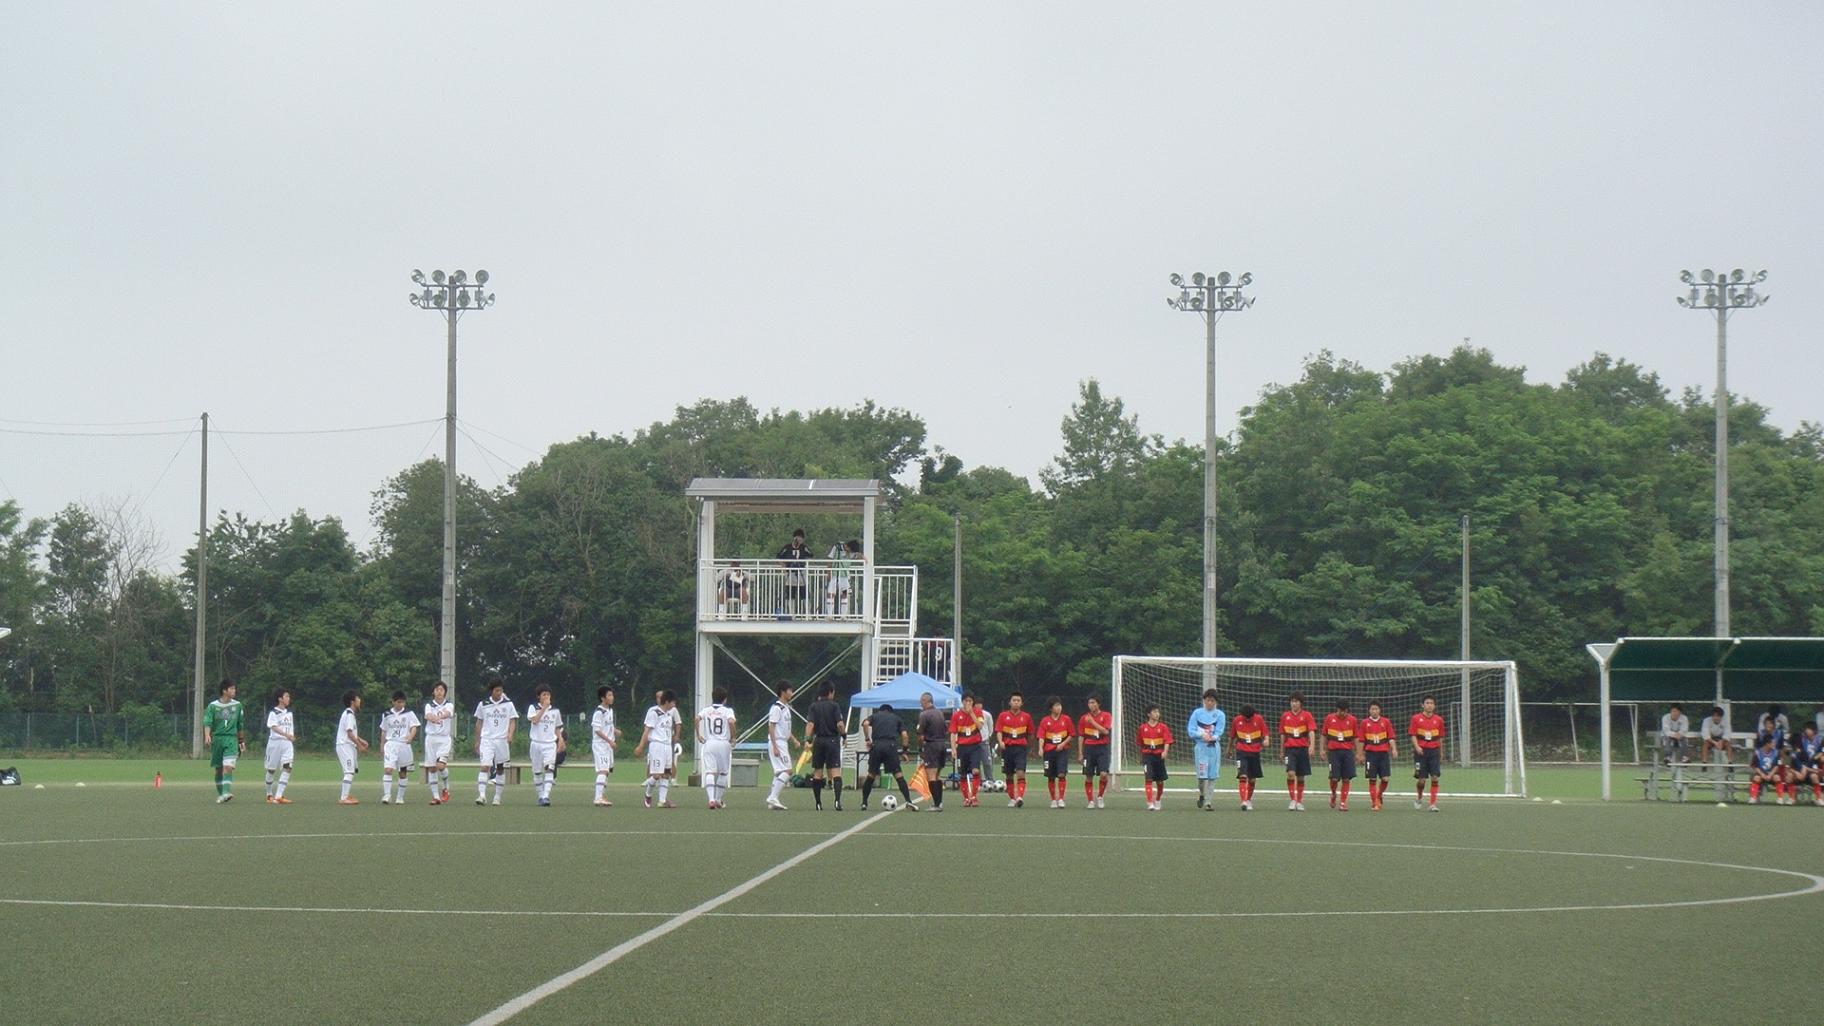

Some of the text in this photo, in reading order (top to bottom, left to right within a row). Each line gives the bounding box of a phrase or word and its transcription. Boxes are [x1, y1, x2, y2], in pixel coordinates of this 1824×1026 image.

[935, 647, 943, 661] 9
[707, 717, 723, 734] 18
[653, 760, 661, 768] 13
[1763, 757, 1772, 771] 3
